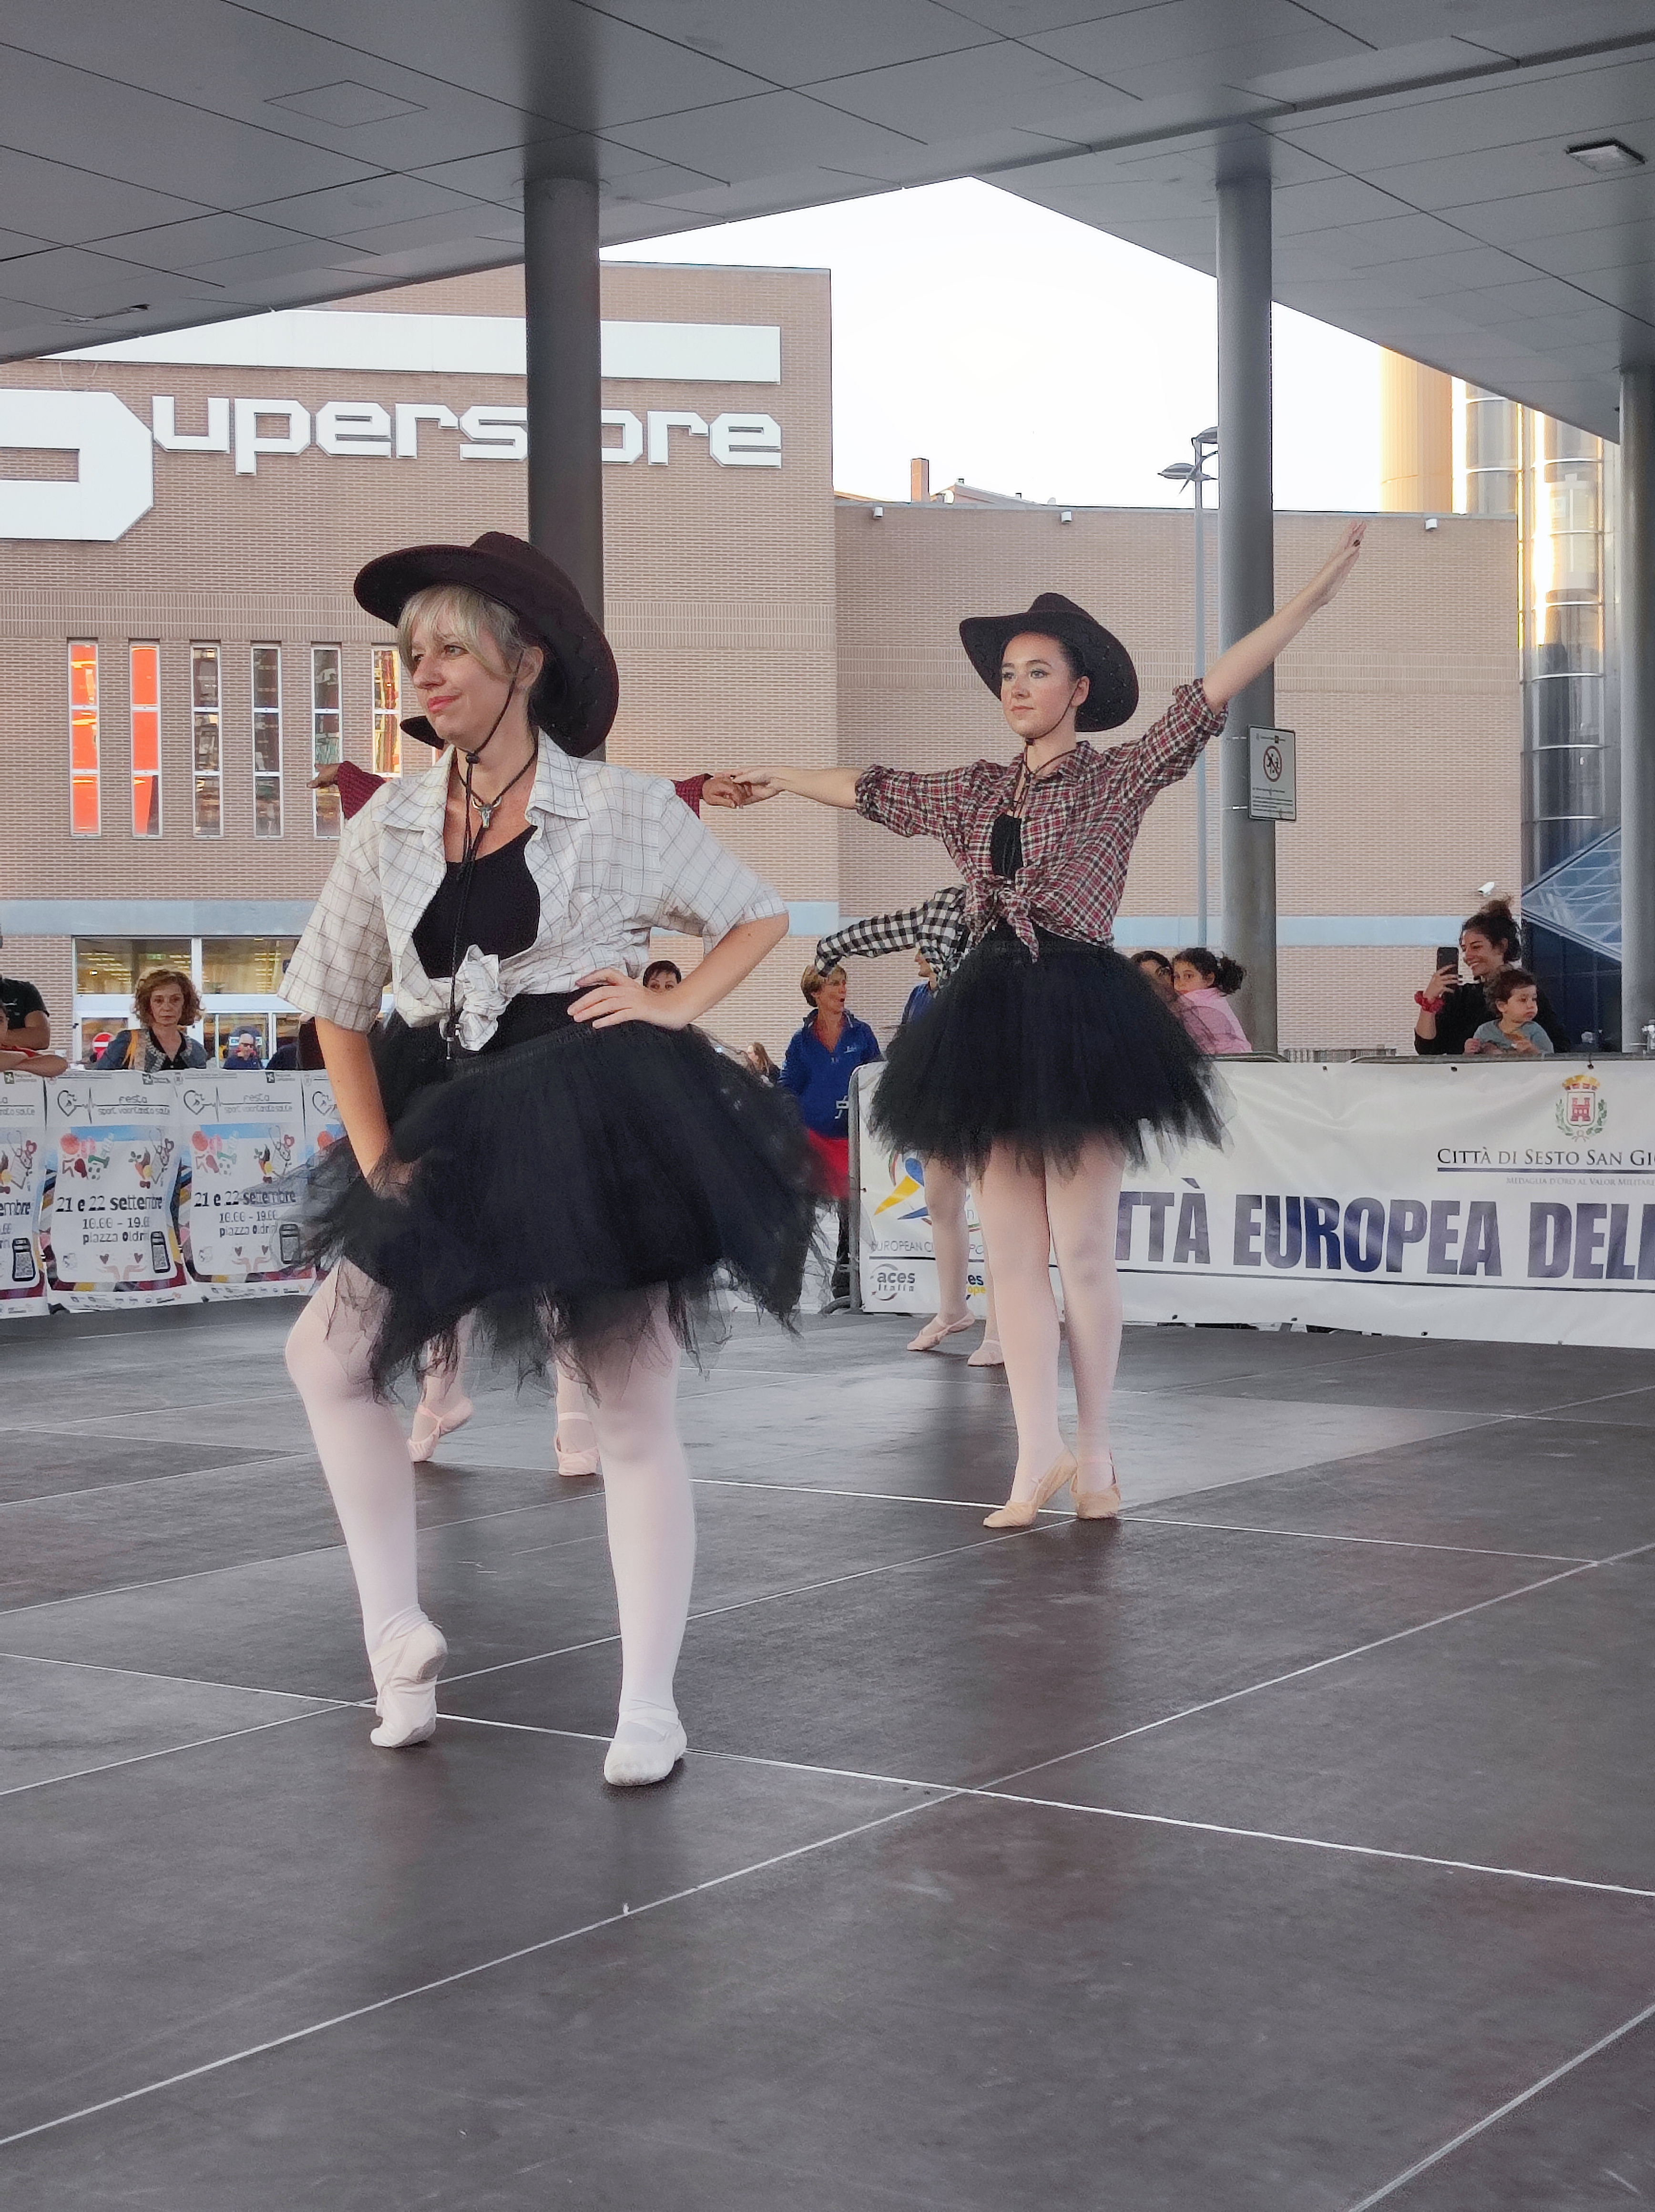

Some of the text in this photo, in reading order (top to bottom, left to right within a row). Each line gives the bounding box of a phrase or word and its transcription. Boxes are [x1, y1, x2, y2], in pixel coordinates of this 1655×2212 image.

[0, 387, 782, 543] upersore
[1437, 1147, 1655, 1166] CITTÀ DI SESTO SAN GI
[55, 1196, 73, 1212] 21
[77, 1199, 85, 1212] e
[88, 1195, 105, 1211] 22
[194, 1192, 209, 1207] 21
[214, 1193, 221, 1207] e
[224, 1190, 239, 1206] 22
[1115, 1177, 1211, 1265] TTÀ
[1233, 1194, 1502, 1277] EUROPEA
[877, 1272, 916, 1283] aces
[968, 1274, 984, 1286] es
[967, 1286, 986, 1296] ope
